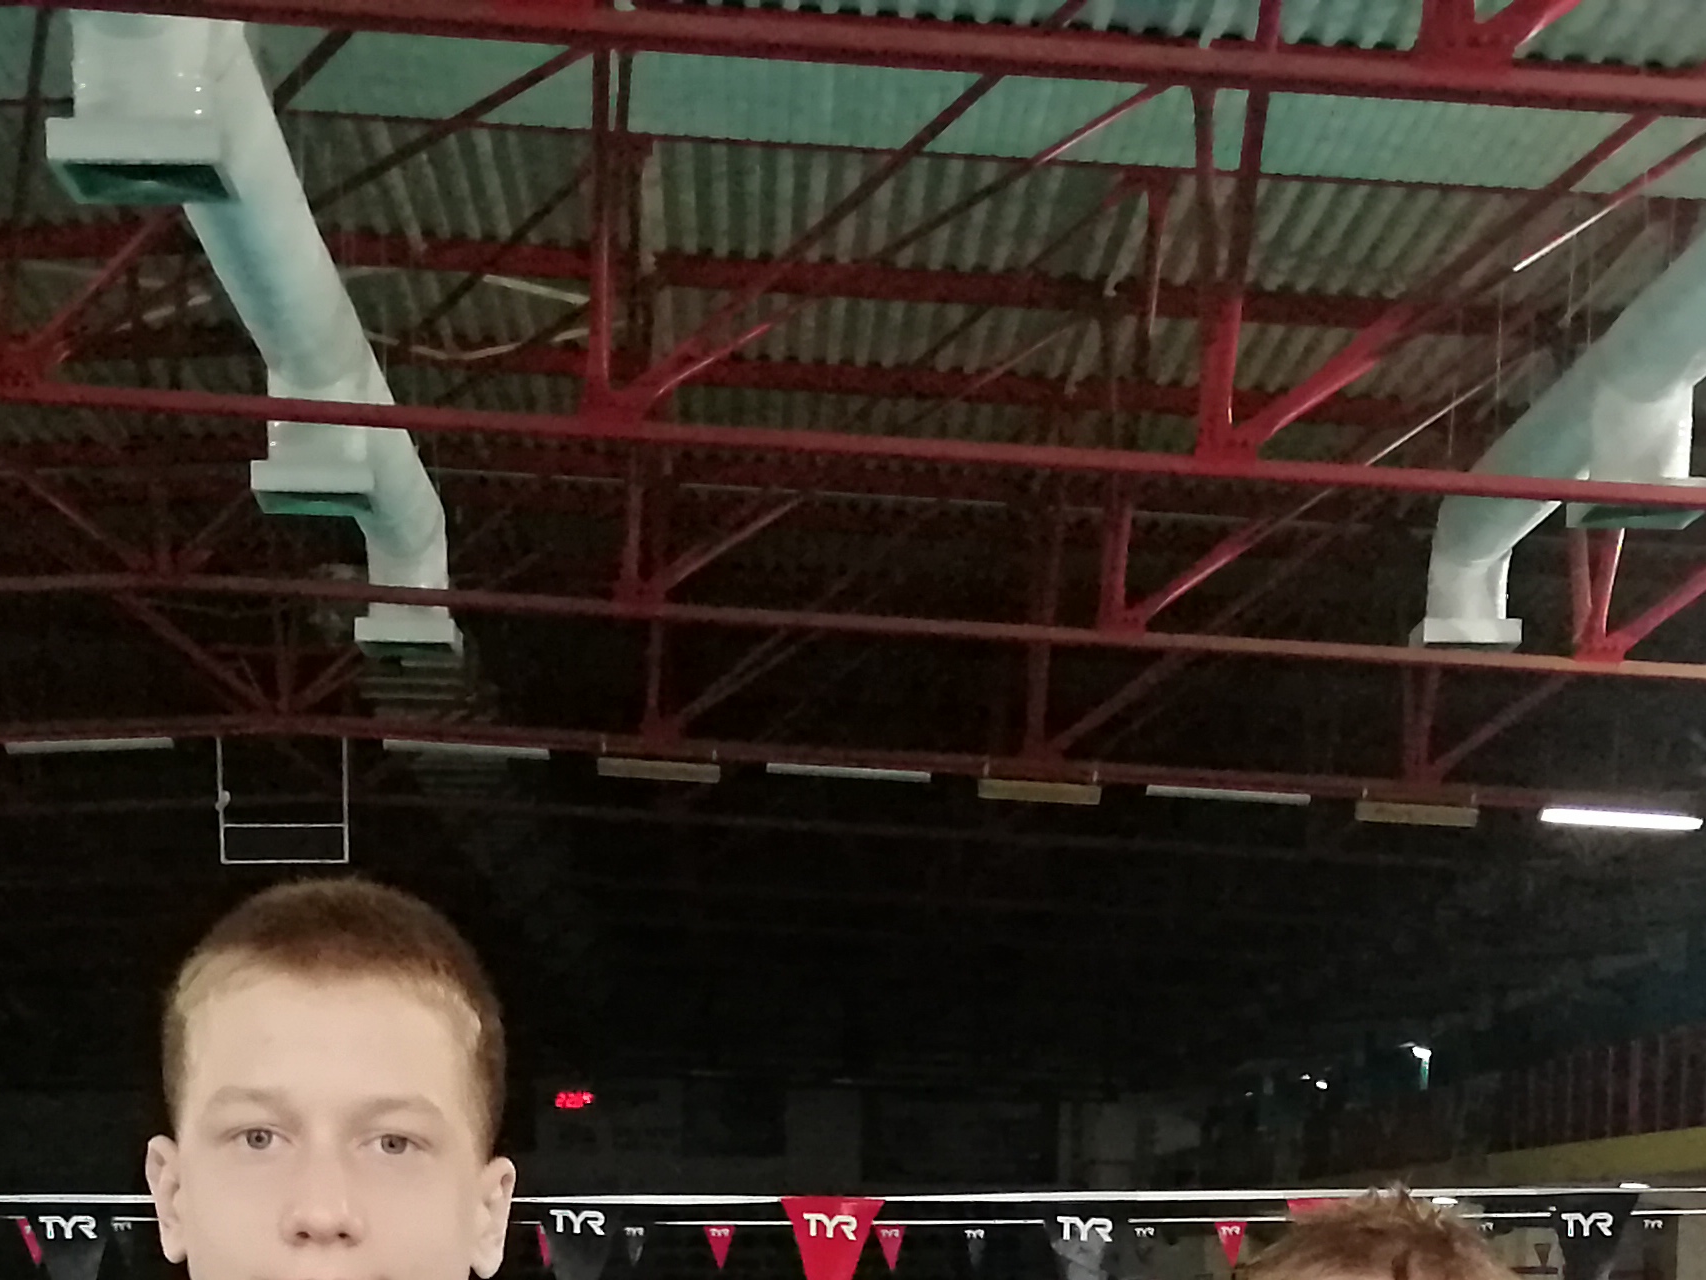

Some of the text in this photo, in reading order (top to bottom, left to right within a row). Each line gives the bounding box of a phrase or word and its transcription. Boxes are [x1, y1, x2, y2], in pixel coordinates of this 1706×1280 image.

[38, 1215, 97, 1240] TYR
[549, 1209, 606, 1236] TYR
[802, 1212, 858, 1241] TYR
[1056, 1215, 1113, 1242] TYR
[1560, 1212, 1614, 1238] TYR
